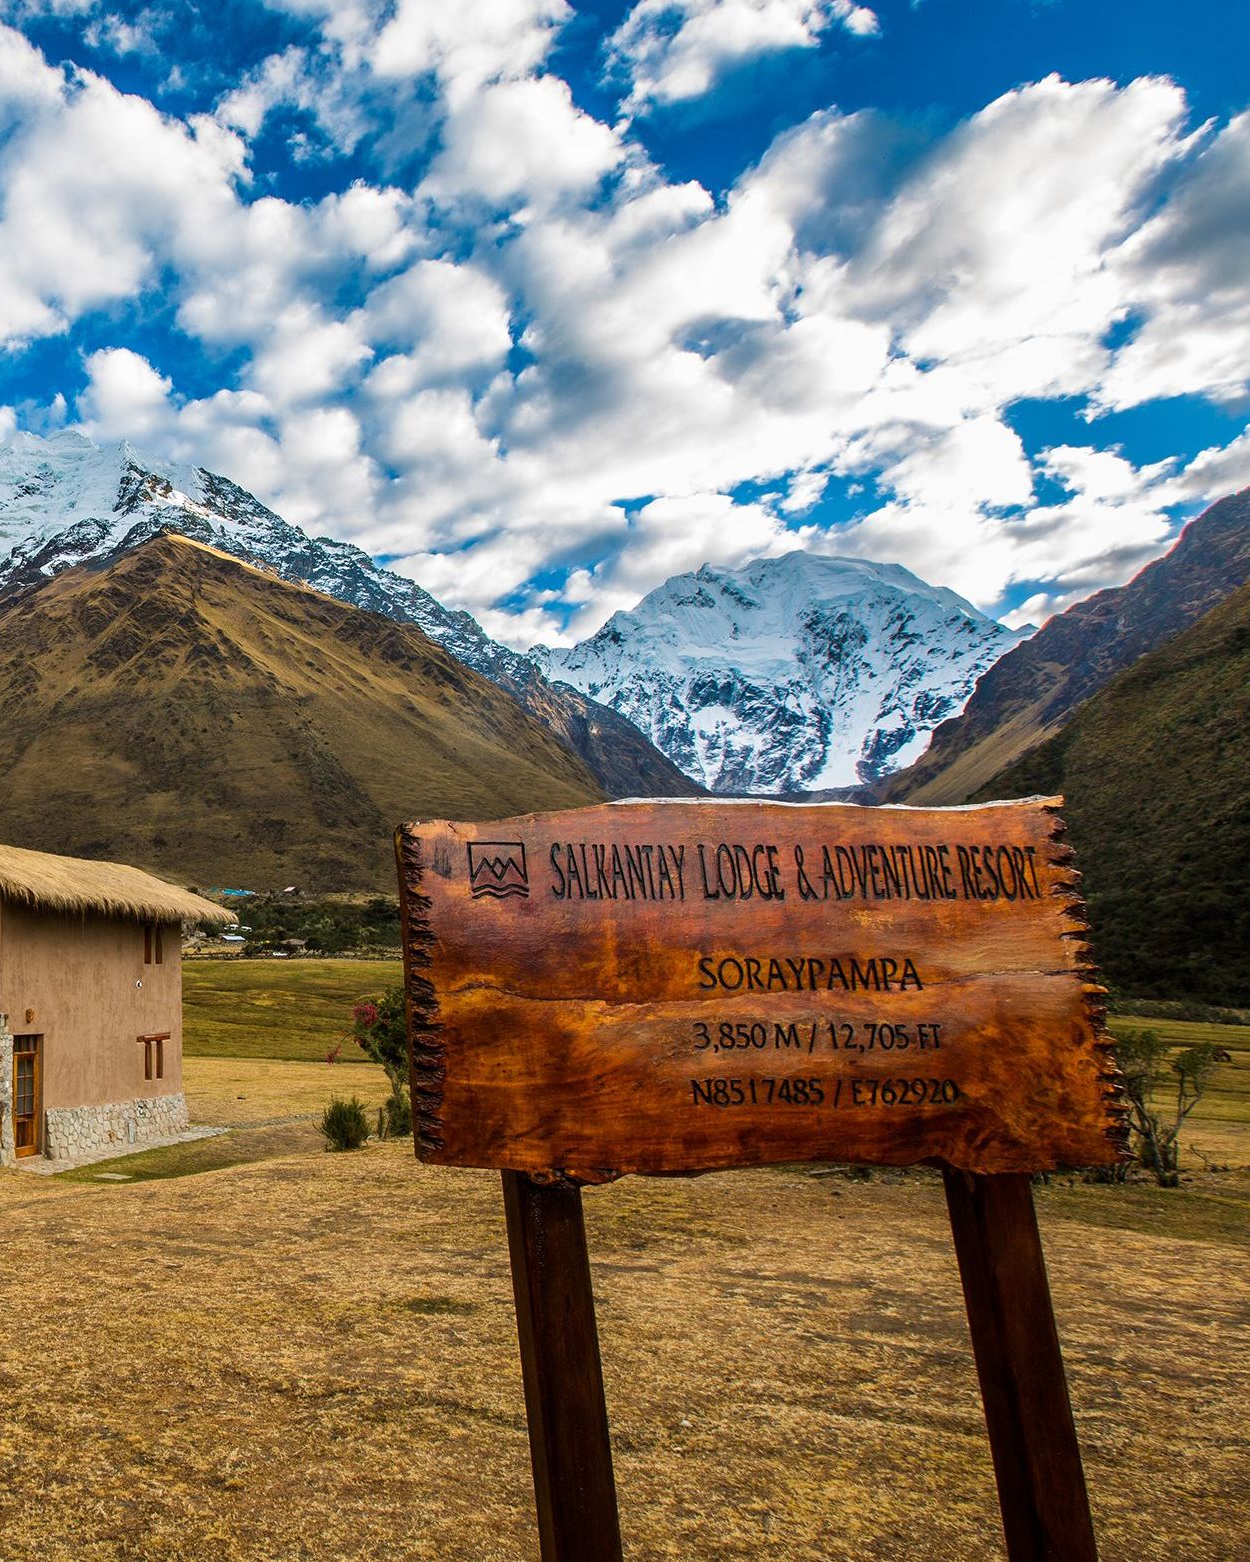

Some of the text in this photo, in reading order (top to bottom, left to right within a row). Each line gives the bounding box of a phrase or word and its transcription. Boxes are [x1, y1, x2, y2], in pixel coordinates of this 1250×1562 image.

[550, 842, 1042, 902] SALKANTAY LODGE & ADVENTURE RESORT
[698, 957, 923, 991] SORAYPAMPA
[693, 1022, 942, 1056] 3,850 M / 12,705 FT
[691, 1078, 959, 1108] N8517485 / E762920
